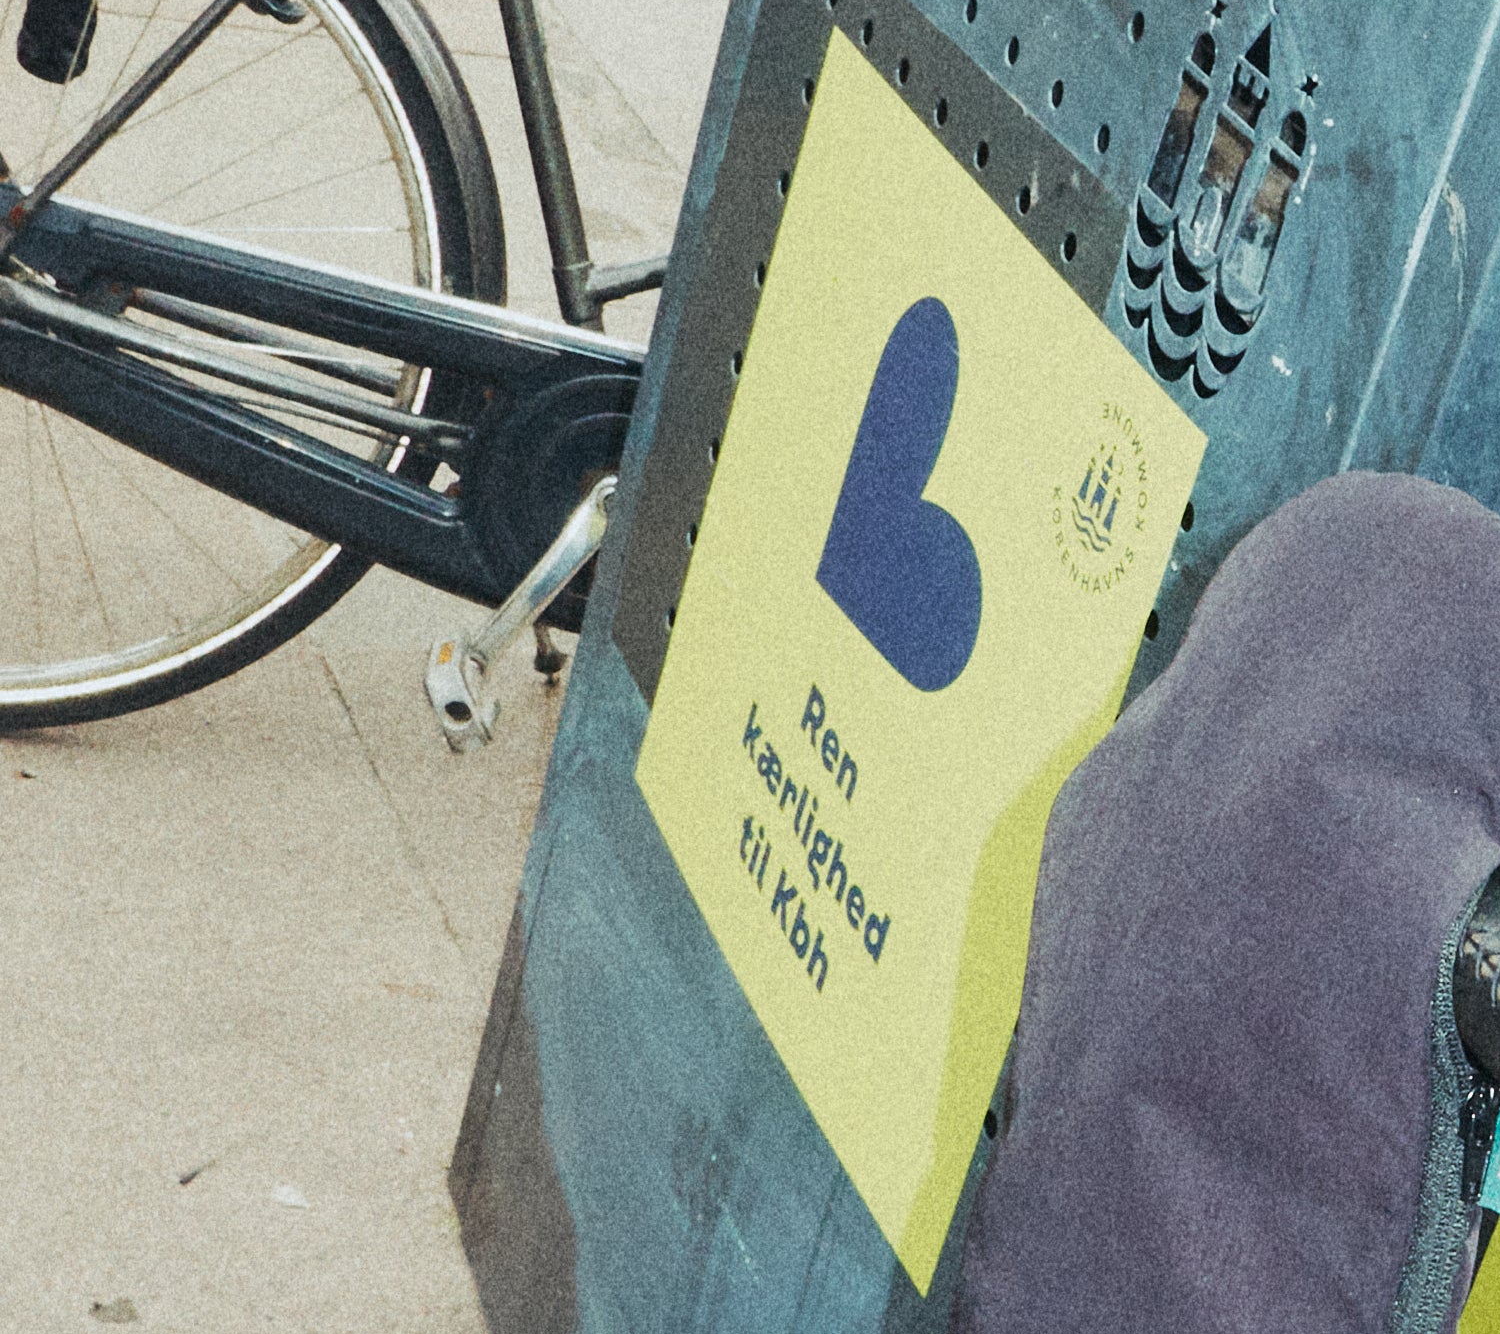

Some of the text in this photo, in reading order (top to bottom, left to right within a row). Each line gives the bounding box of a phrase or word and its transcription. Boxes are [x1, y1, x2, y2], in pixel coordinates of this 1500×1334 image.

[1101, 402, 1149, 532] KOMMUNE
[800, 681, 859, 804] Ren
[739, 815, 829, 996] til Kbh
[742, 699, 892, 965] kærlighed
